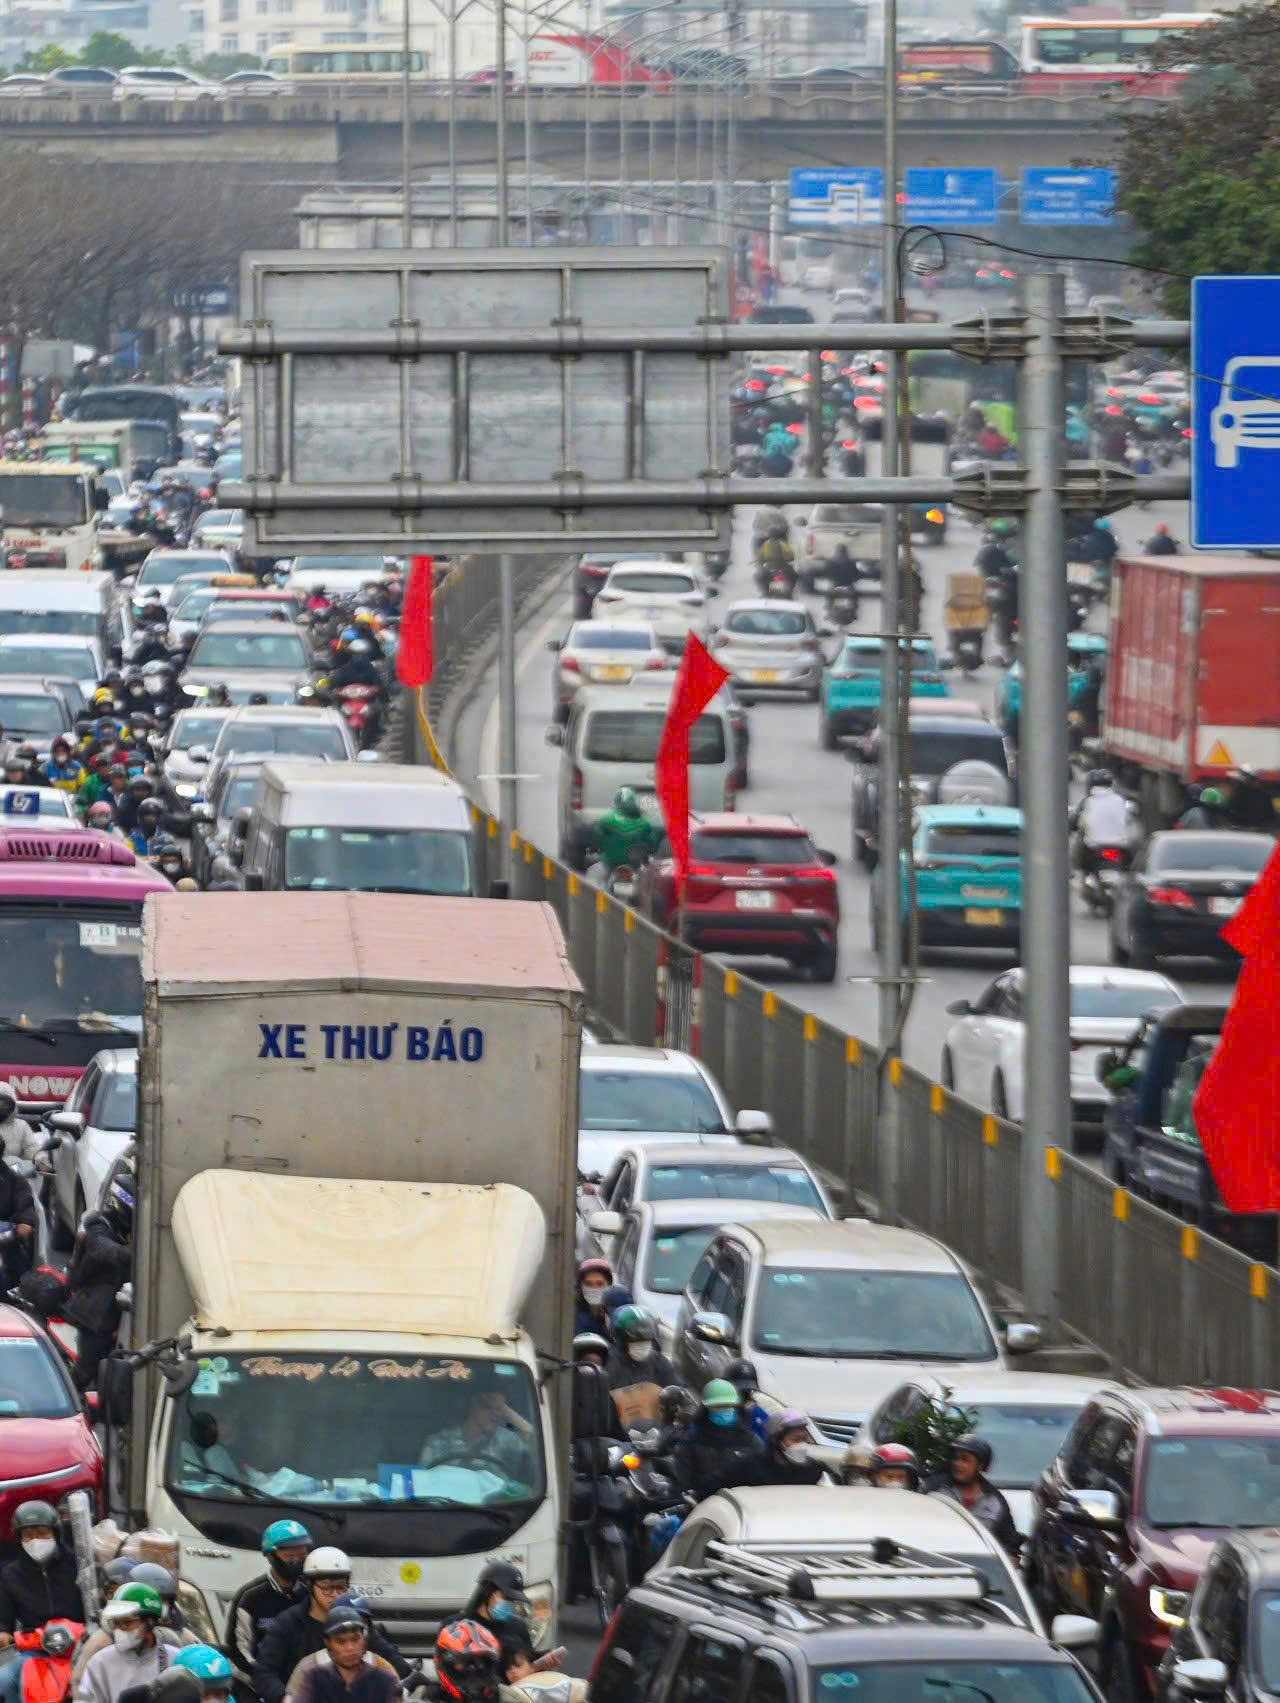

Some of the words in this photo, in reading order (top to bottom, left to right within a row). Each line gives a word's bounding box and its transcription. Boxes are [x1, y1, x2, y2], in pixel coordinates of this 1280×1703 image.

[258, 1023, 307, 1059] XE
[319, 1021, 399, 1060] THƯ
[406, 1018, 483, 1062] BÁO
